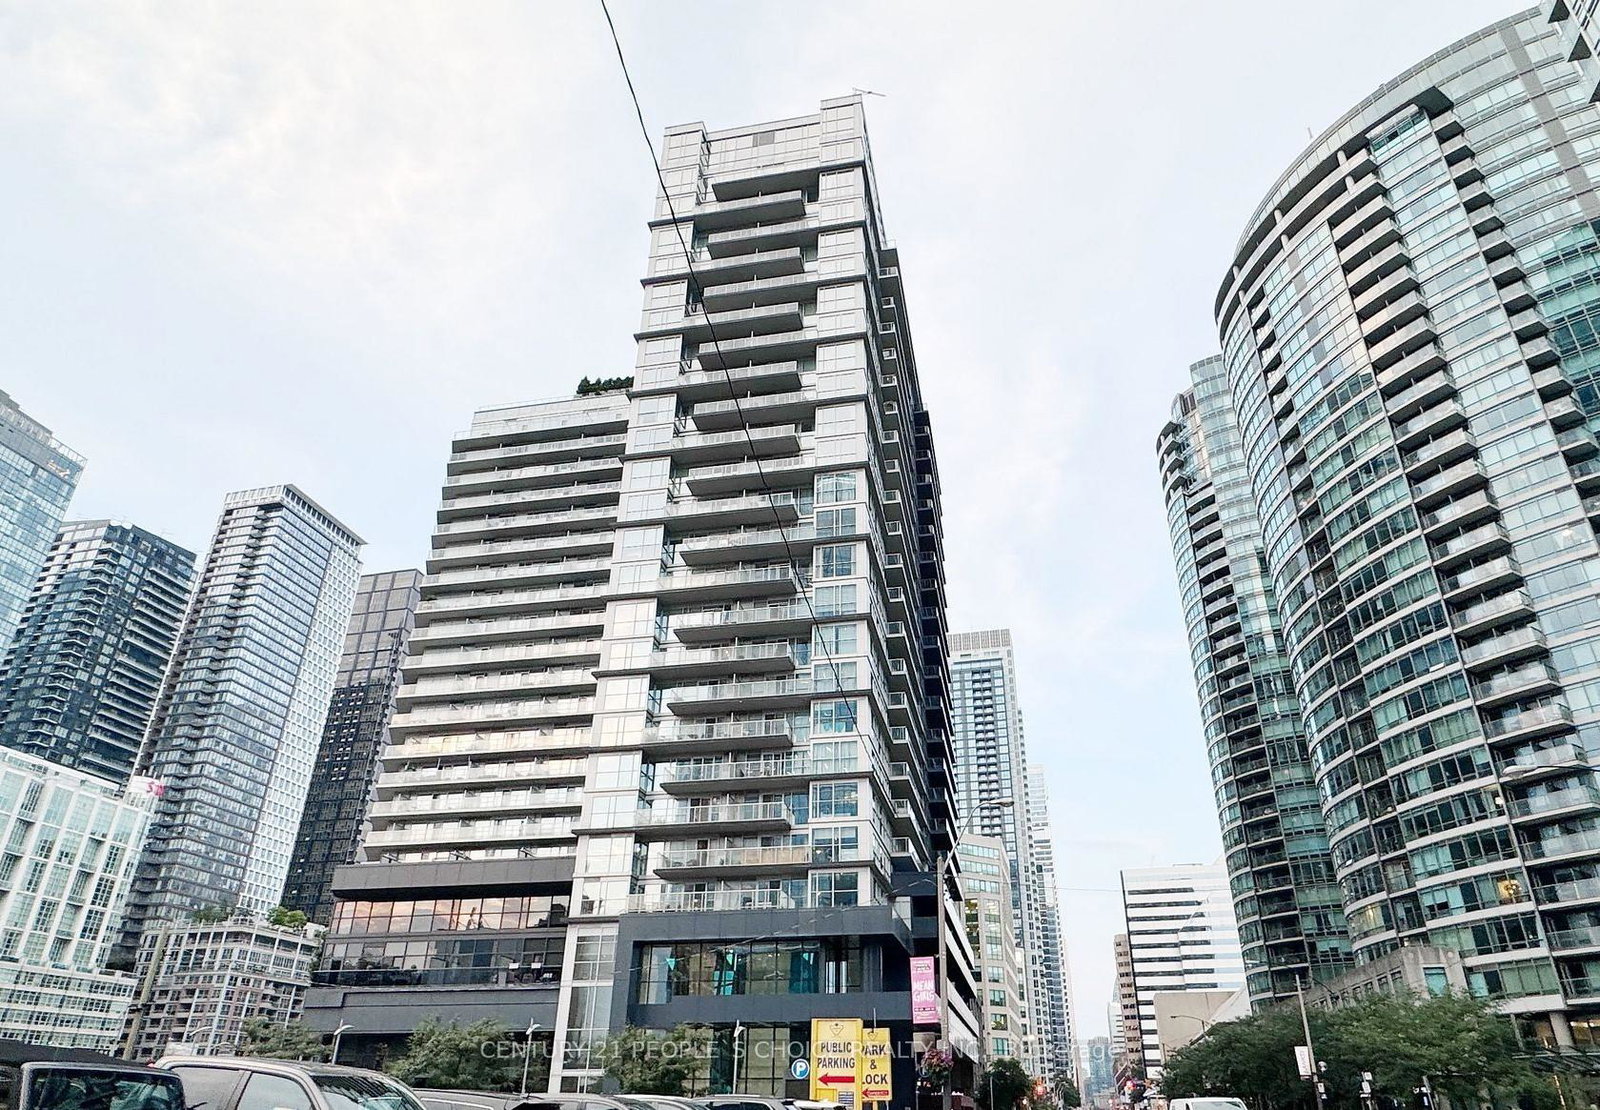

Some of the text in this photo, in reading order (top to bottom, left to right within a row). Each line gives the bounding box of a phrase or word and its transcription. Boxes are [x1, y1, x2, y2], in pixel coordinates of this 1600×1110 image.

[913, 980, 935, 991] MEAN
[914, 991, 935, 1002] GIRLS
[820, 1042, 852, 1053] PUBLIC
[796, 1061, 806, 1076] P
[817, 1057, 855, 1069] PARKING
[869, 1059, 877, 1070] &
